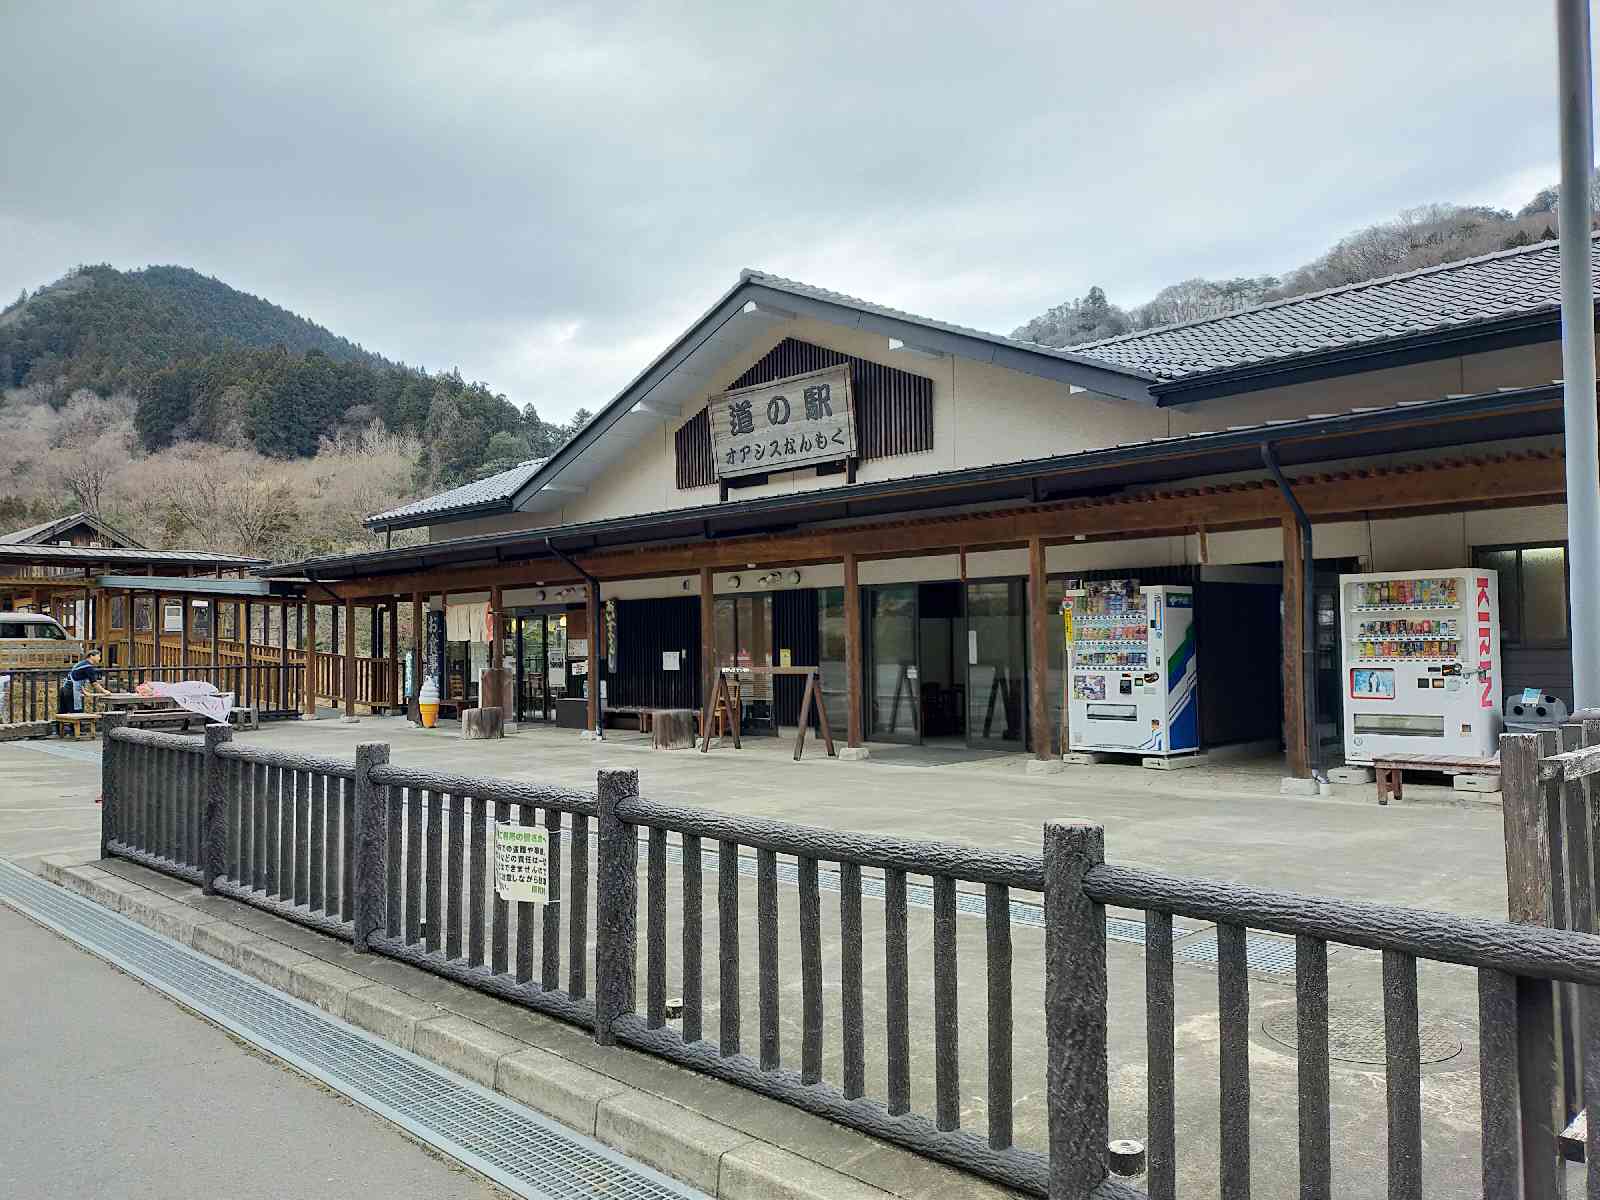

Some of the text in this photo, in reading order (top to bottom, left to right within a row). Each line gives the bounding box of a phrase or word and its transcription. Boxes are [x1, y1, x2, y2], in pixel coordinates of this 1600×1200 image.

[728, 383, 832, 436] 道の駅
[726, 428, 845, 465] オアシスなんもく
[1476, 577, 1493, 708] KIRIN
